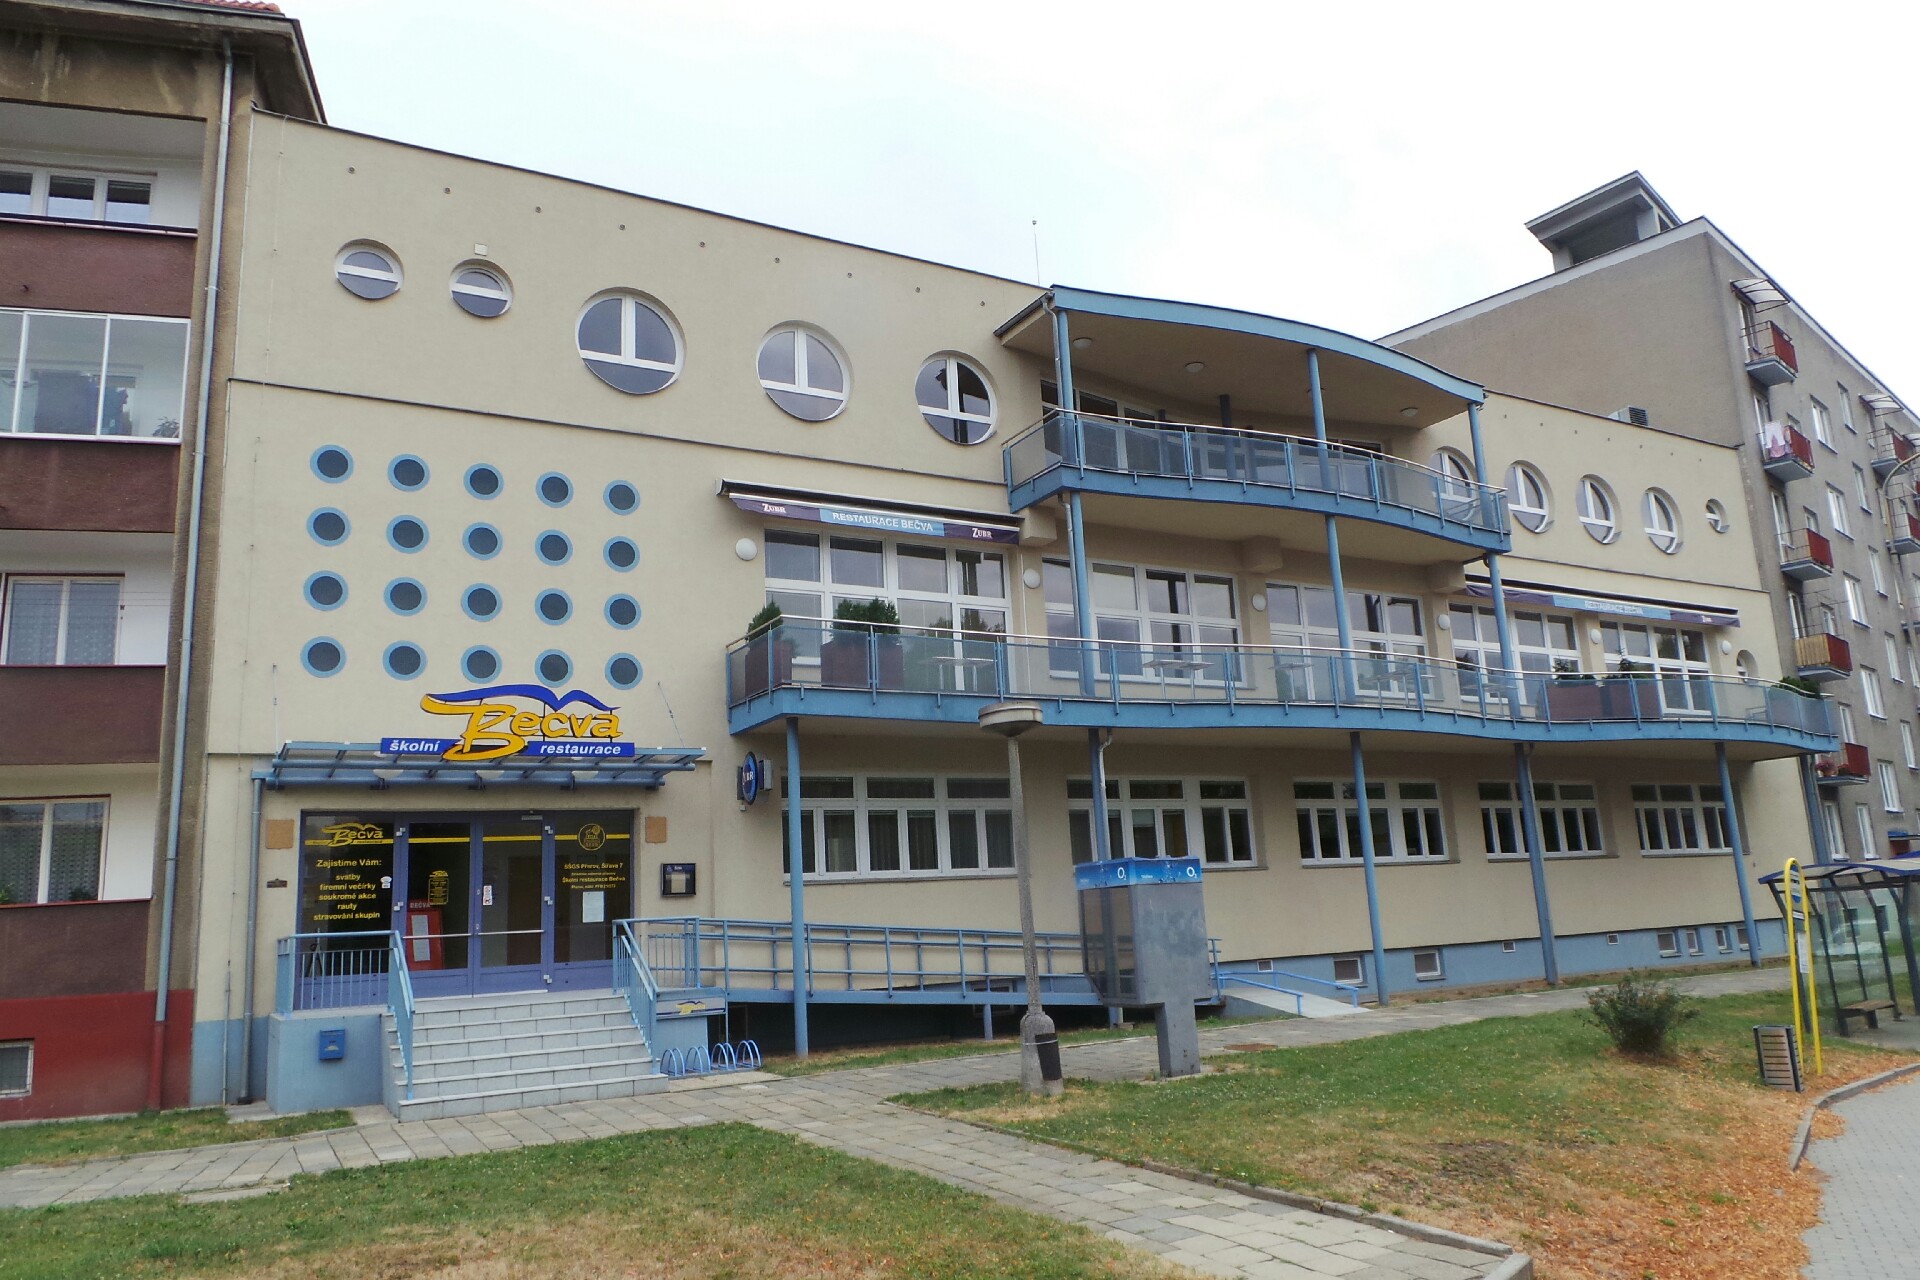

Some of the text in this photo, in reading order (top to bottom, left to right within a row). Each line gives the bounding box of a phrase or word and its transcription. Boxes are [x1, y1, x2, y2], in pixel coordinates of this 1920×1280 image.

[762, 503, 786, 513] ZUBR
[832, 512, 934, 532] RESTAURACE BEČVA
[972, 527, 993, 539] ZUBR
[389, 739, 440, 752] školní
[540, 743, 621, 755] restaurace
[335, 874, 361, 882] svatby
